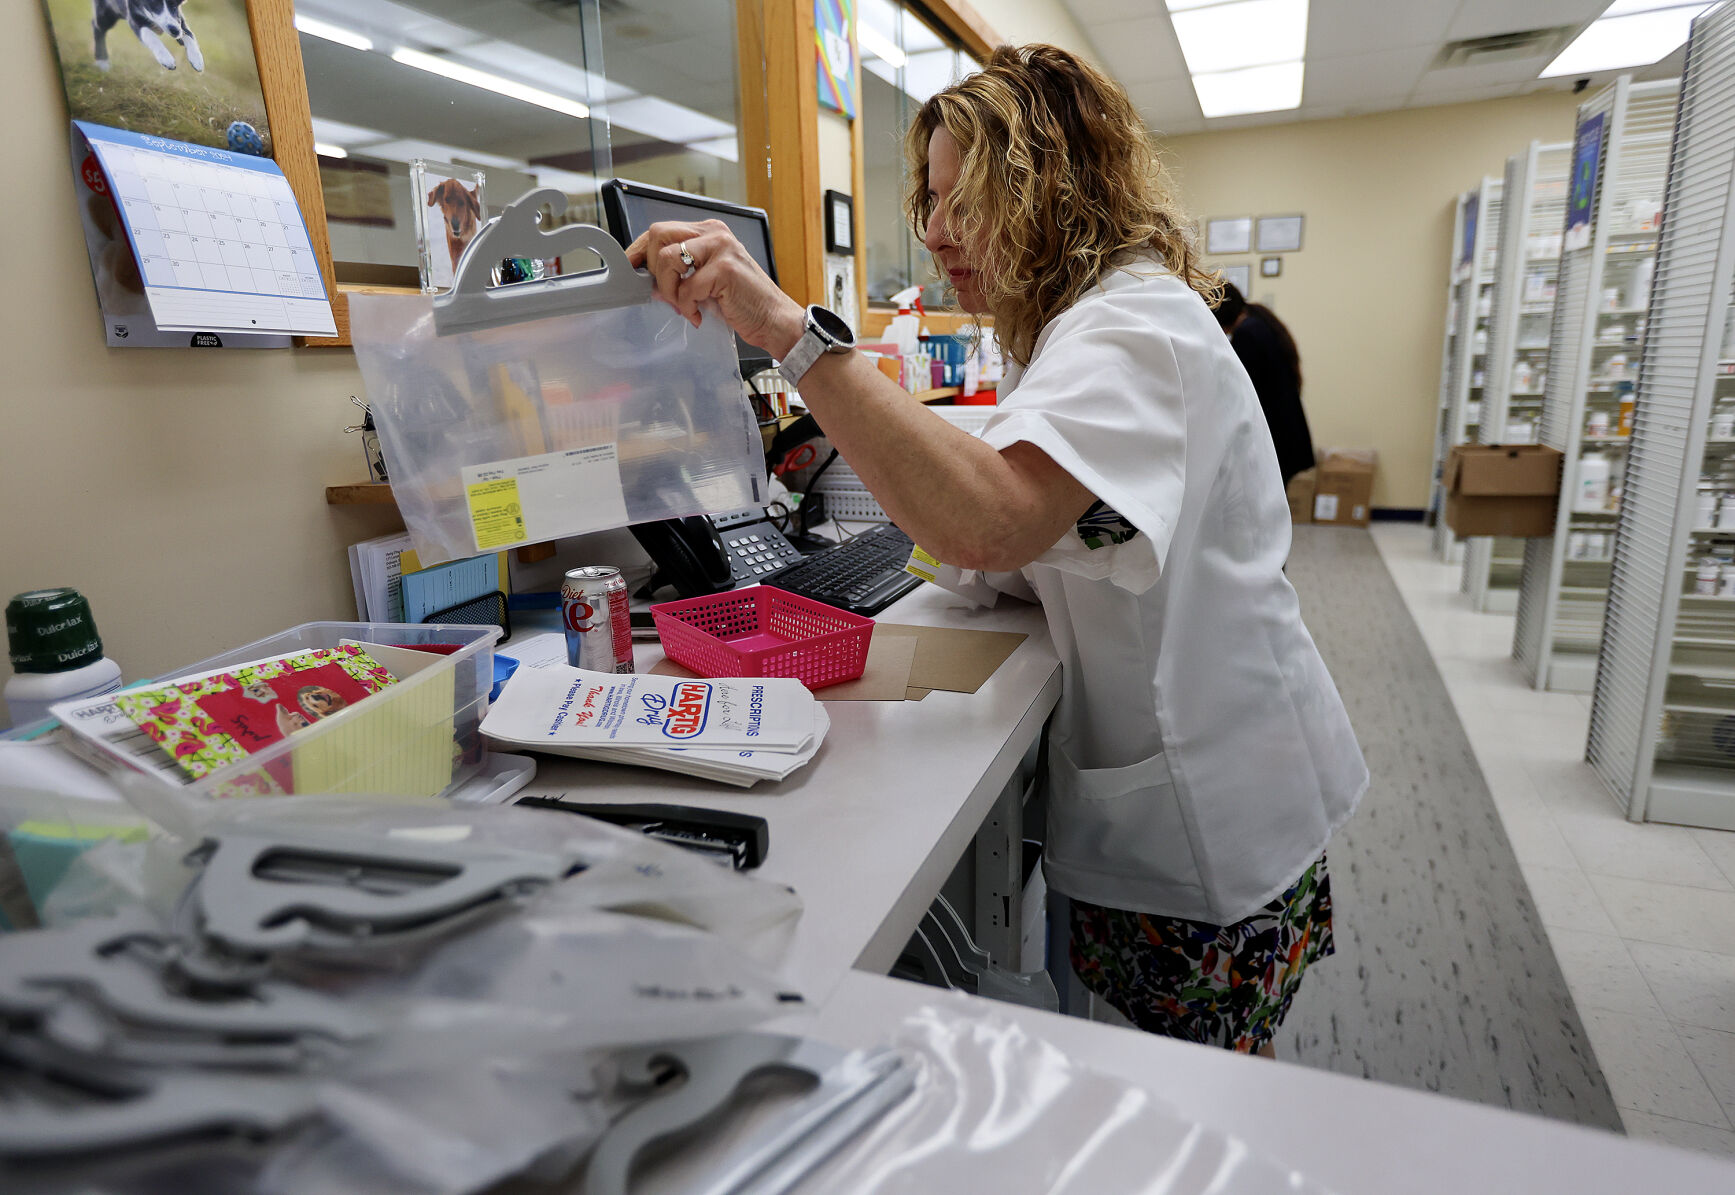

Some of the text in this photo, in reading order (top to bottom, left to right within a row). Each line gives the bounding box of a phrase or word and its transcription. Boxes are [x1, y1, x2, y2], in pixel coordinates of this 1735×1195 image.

[140, 134, 207, 157] September
[561, 584, 585, 601] Diet
[550, 683, 582, 731] Please Pay Cashier
[584, 685, 604, 708] Thank
[636, 693, 667, 725] Drug
